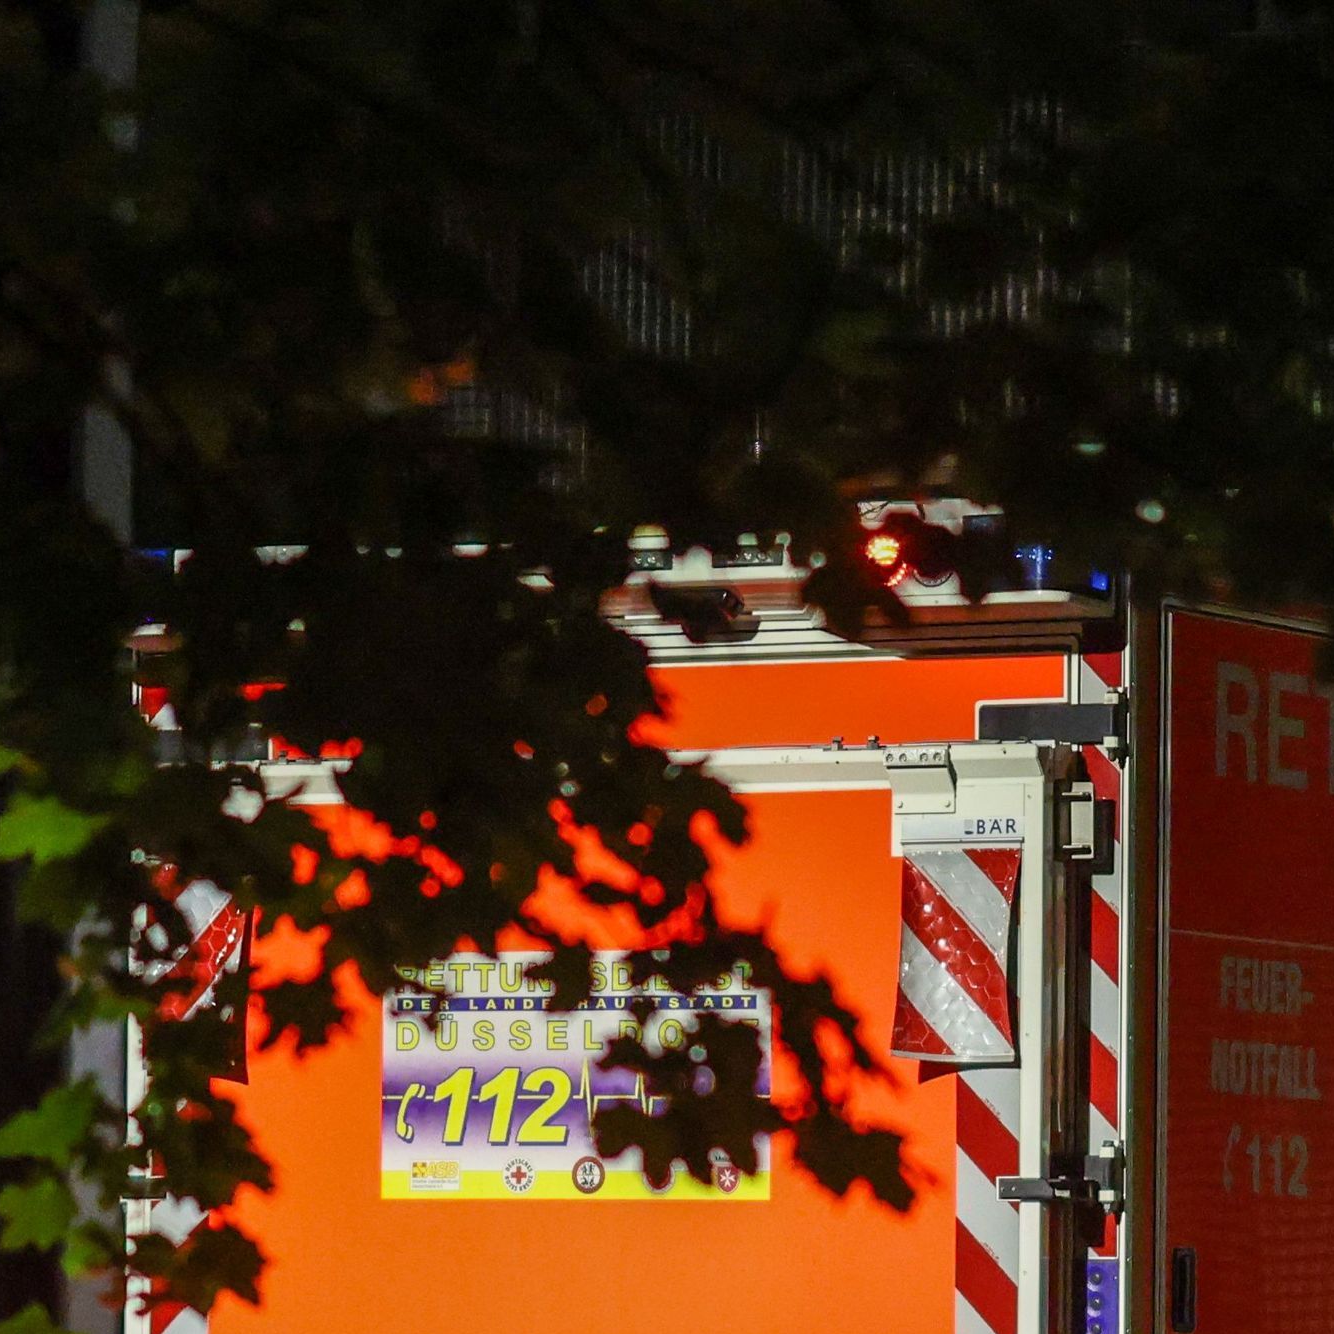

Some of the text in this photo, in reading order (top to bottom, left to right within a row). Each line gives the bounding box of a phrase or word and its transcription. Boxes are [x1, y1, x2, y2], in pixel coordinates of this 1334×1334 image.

[976, 818, 1017, 835] BÄR
[401, 998, 450, 1011] DER
[1220, 955, 1315, 1016] FEUER-
[1210, 1036, 1322, 1101] NOTFALL
[433, 1066, 571, 1146] 112
[1245, 1134, 1309, 1197] 112
